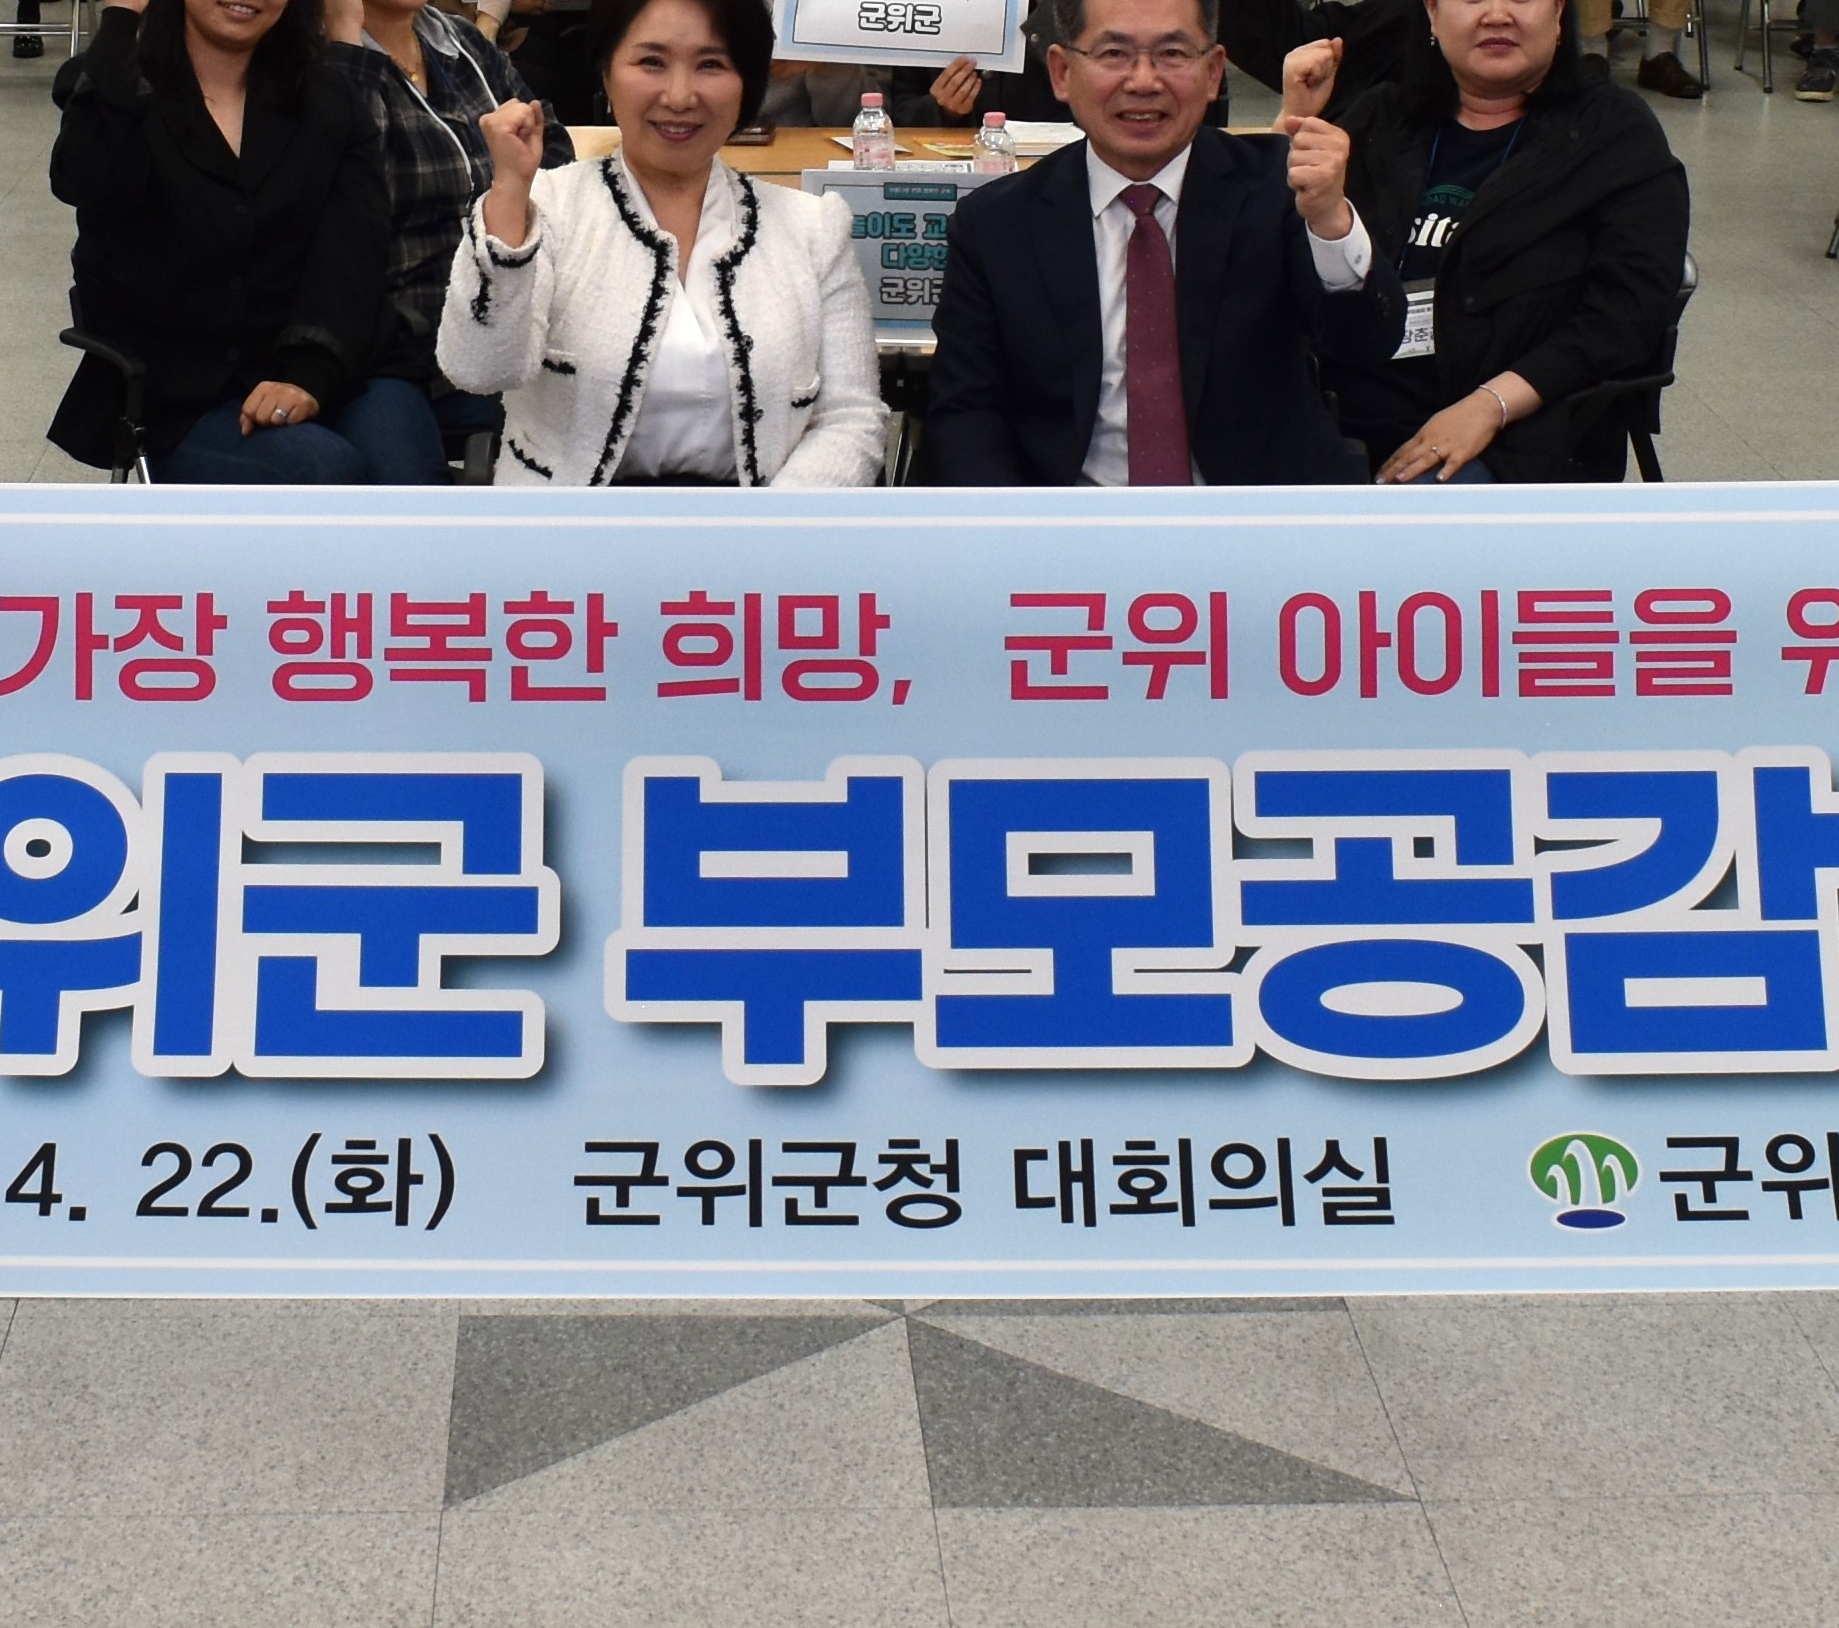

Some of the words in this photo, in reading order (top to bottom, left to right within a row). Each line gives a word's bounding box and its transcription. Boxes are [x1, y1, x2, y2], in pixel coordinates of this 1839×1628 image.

[858, 1, 942, 35] 군위군
[267, 590, 619, 702] 행복한
[657, 590, 911, 704] 희망,
[1004, 592, 1228, 700] 군위
[1279, 589, 1737, 698] 아이들을
[4, 1141, 88, 1222] 4.
[135, 1132, 458, 1231] 22.(화)
[572, 1137, 963, 1229] 군위군청
[1012, 1135, 1396, 1229] 대회의실
